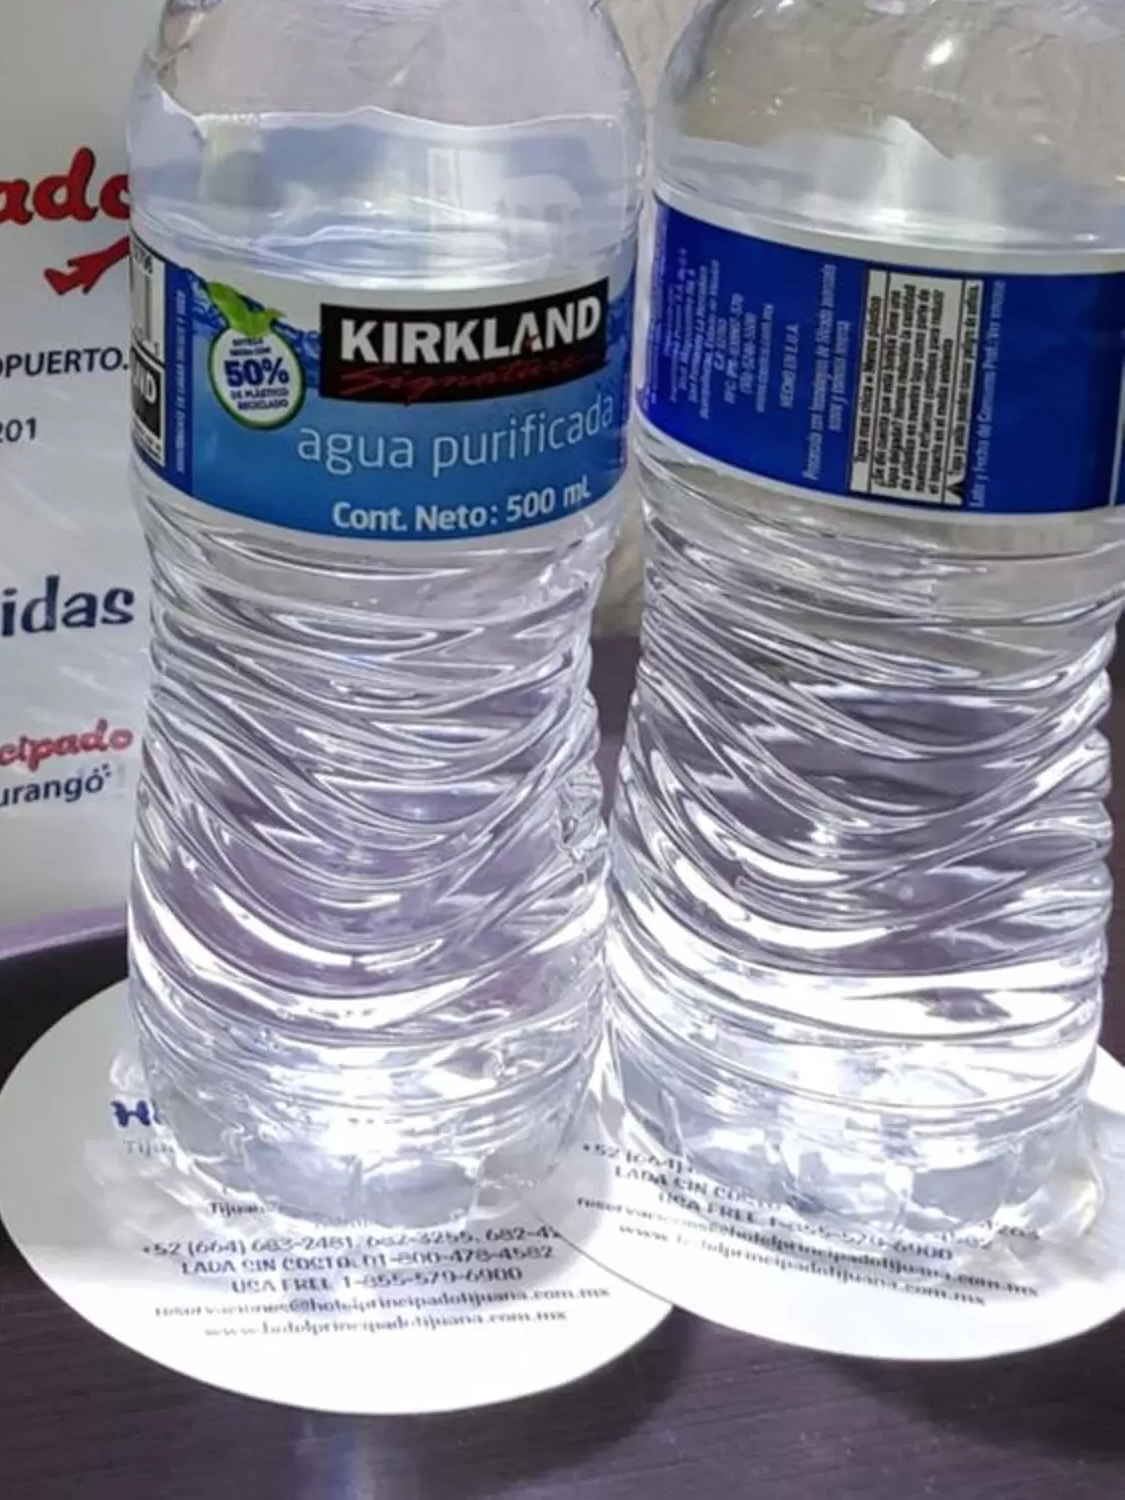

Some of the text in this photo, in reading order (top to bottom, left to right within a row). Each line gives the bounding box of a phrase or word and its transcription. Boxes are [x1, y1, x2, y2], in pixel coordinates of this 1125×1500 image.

[341, 297, 602, 363] KIRKLAND
[224, 357, 289, 387] 50%
[297, 394, 614, 477] agua purificada
[332, 501, 407, 532] Cont.
[415, 499, 498, 532] Neto:
[507, 488, 555, 524] 500
[182, 1259, 235, 1275] LADA
